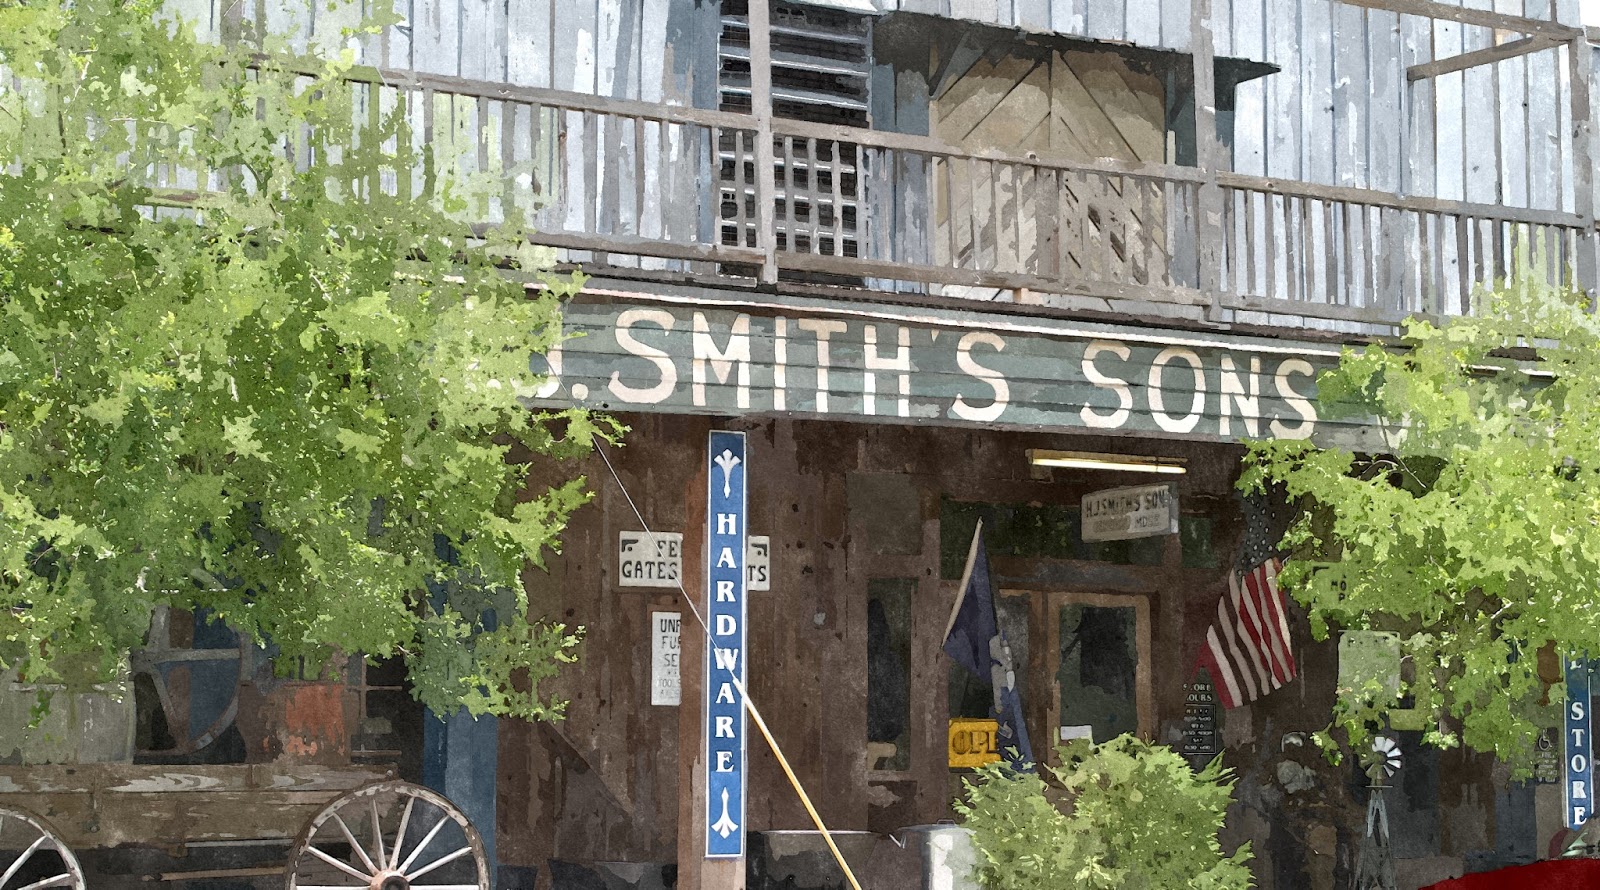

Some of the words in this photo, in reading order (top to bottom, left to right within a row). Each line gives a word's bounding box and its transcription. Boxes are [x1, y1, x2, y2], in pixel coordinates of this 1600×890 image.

[1080, 339, 1318, 441] SONS
[657, 540, 682, 558] FE
[621, 560, 678, 580] GATES
[714, 513, 738, 772] HARDWARE
[1183, 683, 1212, 691] SORE
[1186, 693, 1212, 702] OURS
[1570, 701, 1588, 826] STORE
